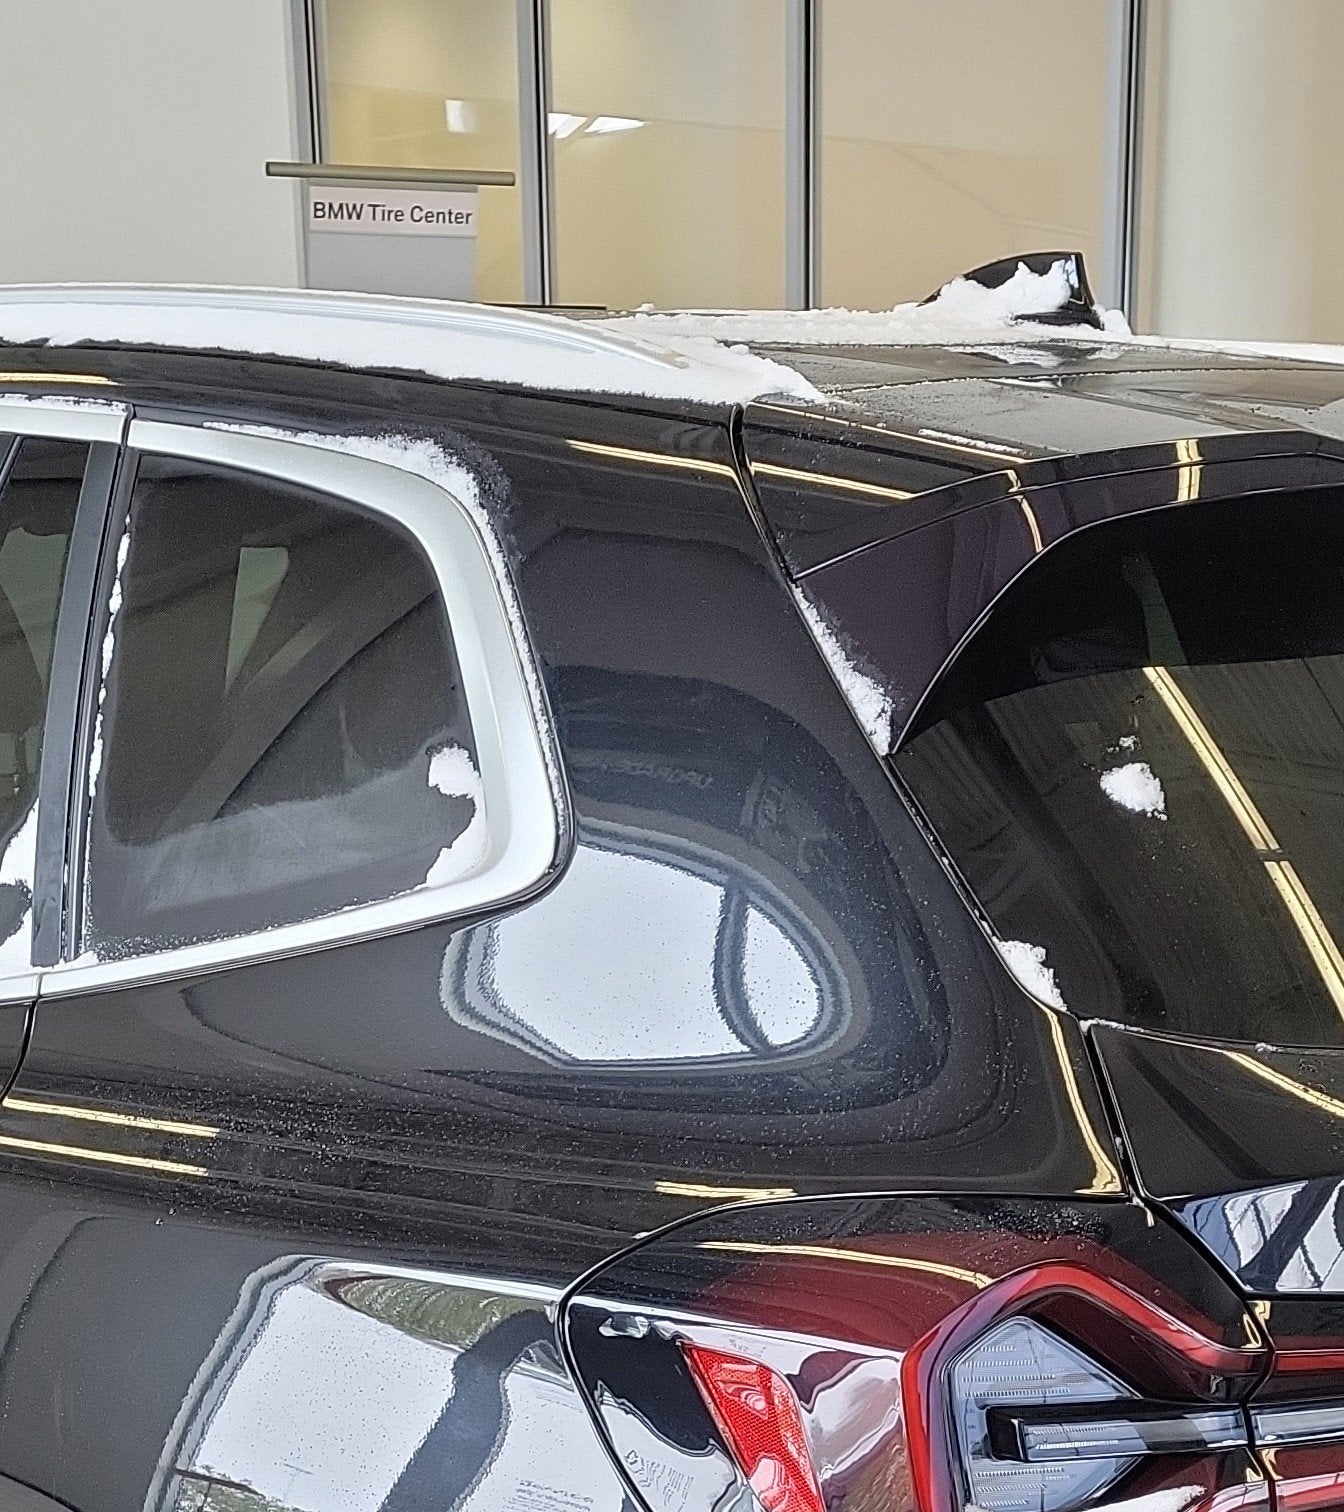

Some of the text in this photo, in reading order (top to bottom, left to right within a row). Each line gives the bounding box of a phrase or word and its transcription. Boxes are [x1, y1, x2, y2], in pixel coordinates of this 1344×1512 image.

[313, 201, 473, 225] BMW Tire Center
